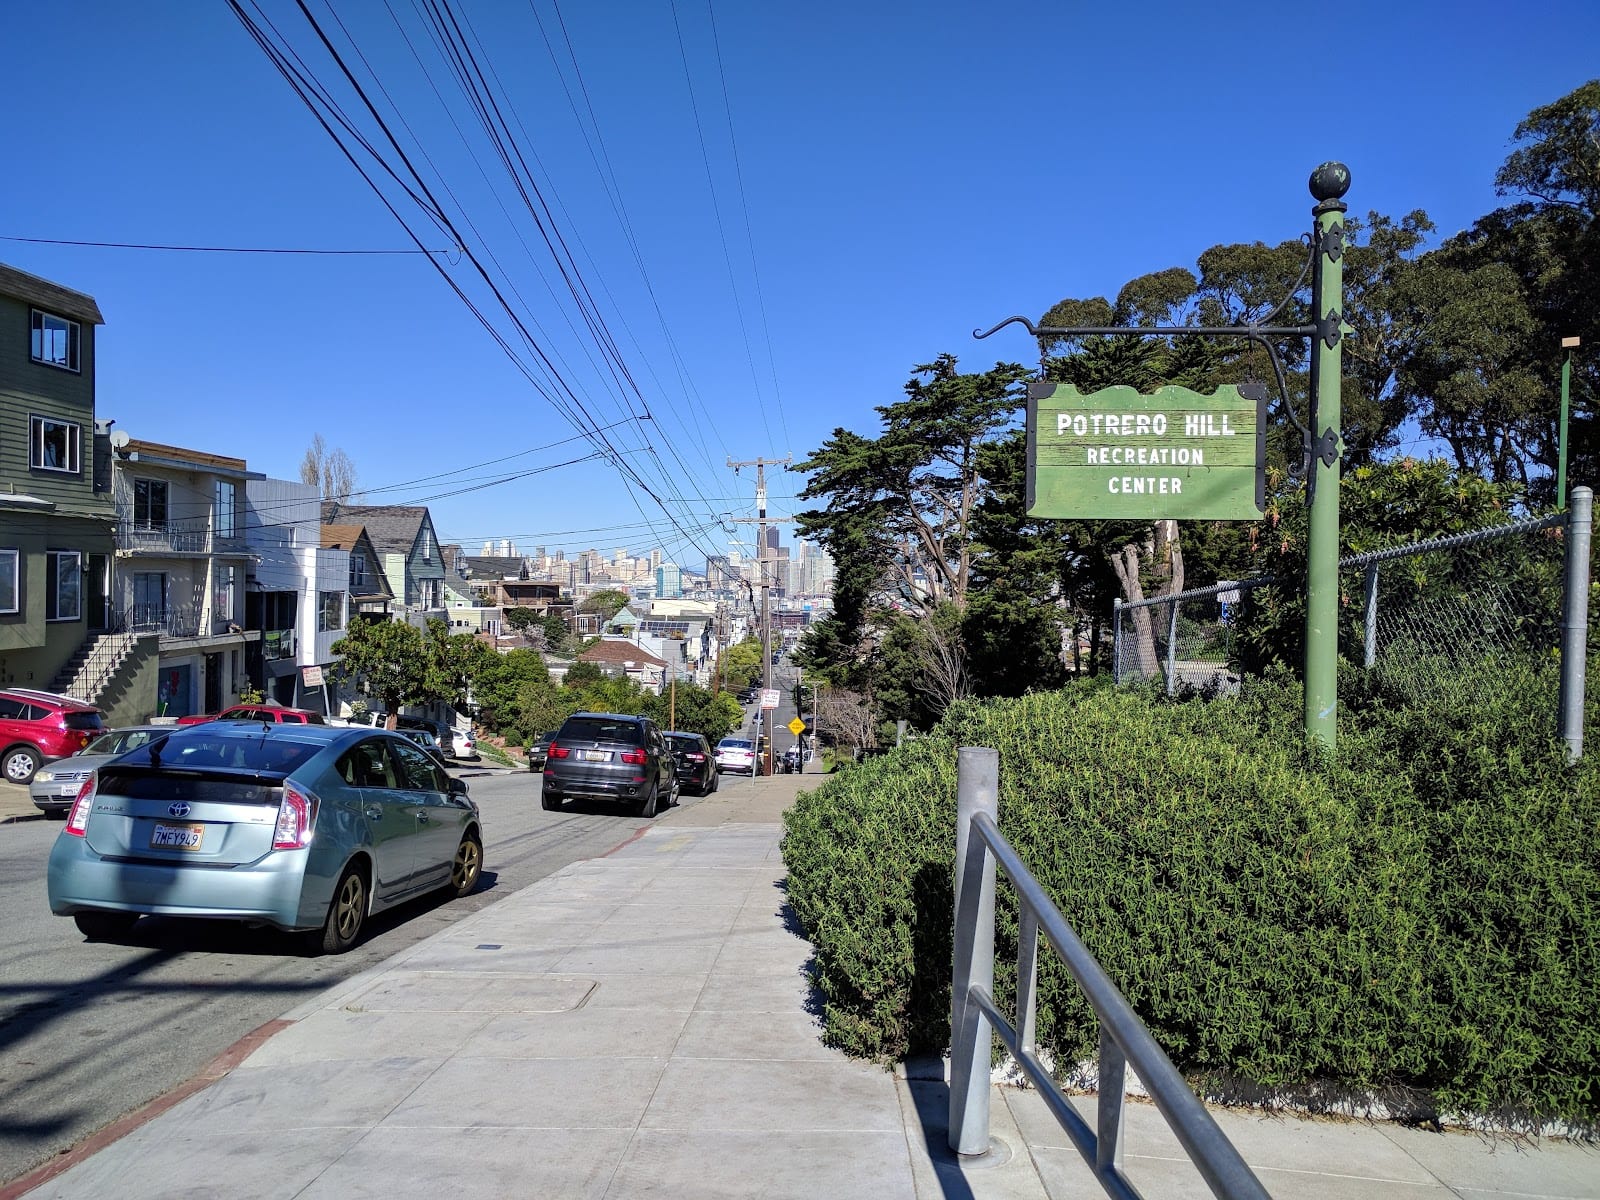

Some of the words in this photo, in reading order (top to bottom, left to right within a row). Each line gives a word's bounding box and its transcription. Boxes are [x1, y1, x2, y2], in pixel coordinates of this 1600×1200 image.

[1057, 413, 1167, 436] POTRERO
[1185, 414, 1235, 436] HILL
[1087, 448, 1203, 465] RECREATION
[1108, 477, 1182, 494] CENTER
[155, 831, 199, 847] 7MFY949
